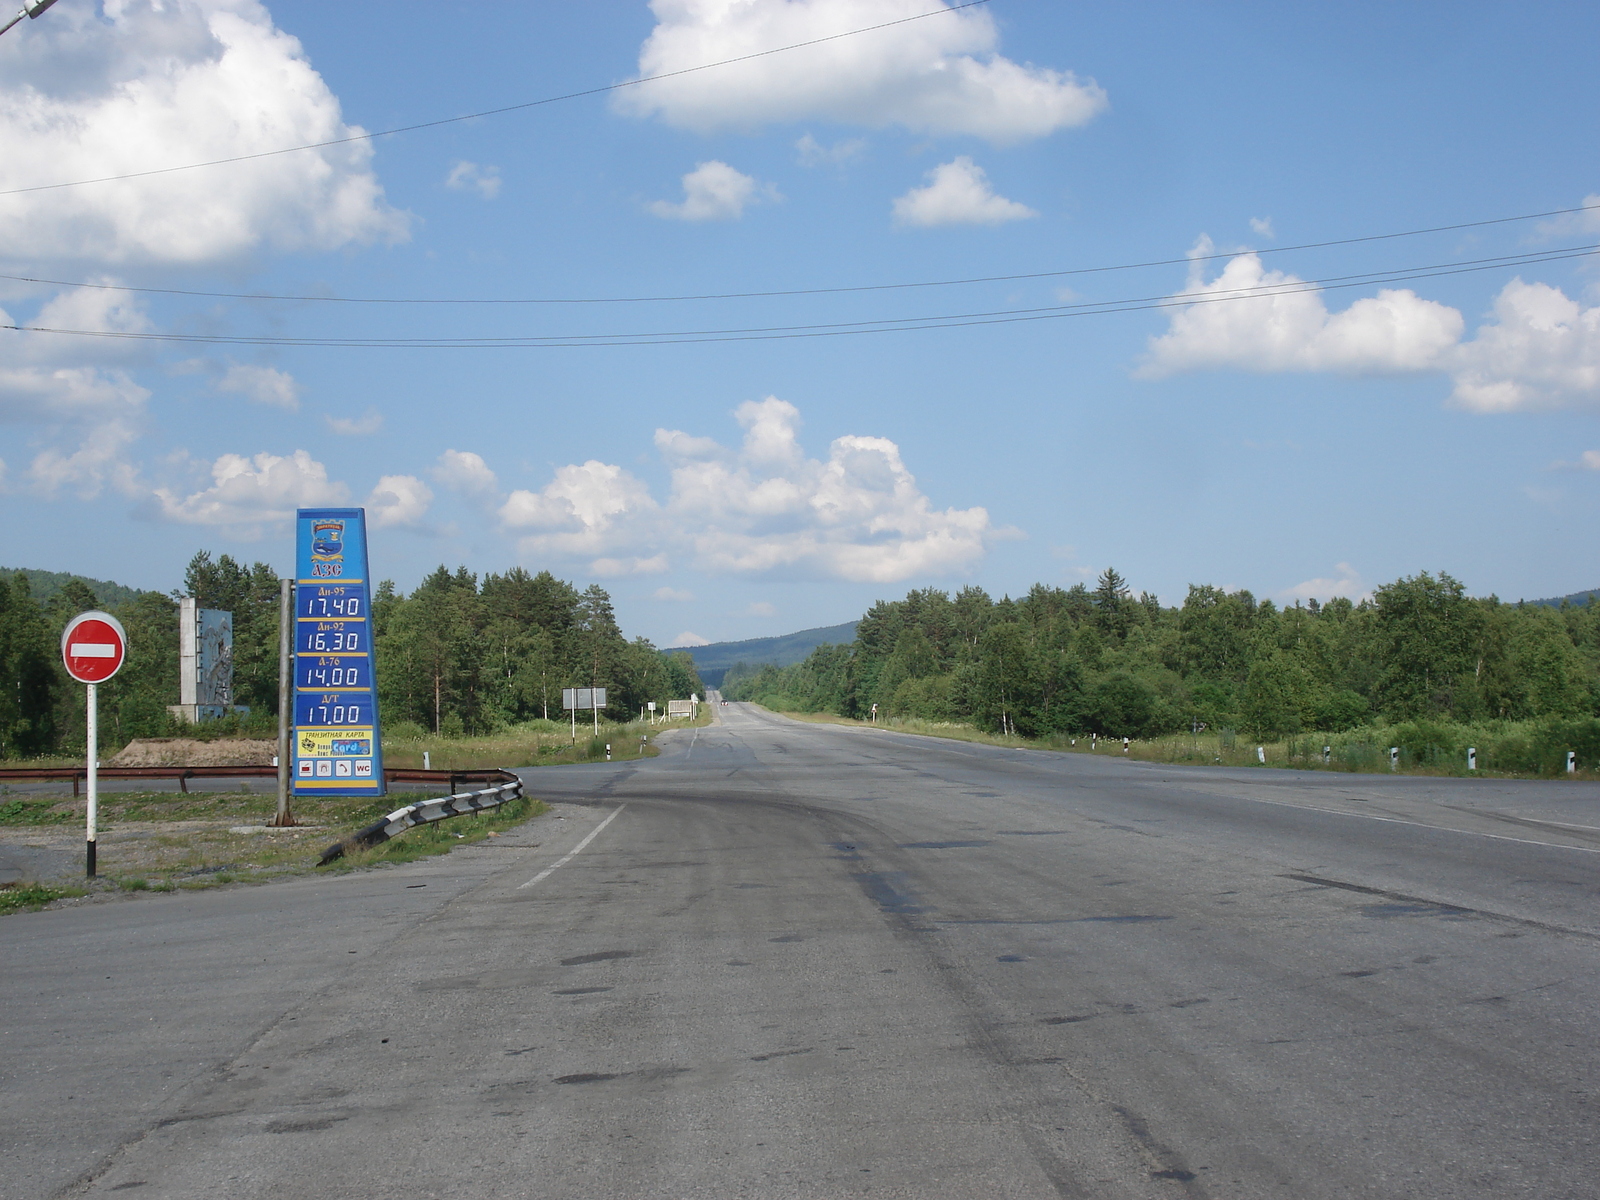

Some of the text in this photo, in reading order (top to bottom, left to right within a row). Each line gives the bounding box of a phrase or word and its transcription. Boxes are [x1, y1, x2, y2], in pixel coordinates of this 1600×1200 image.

[311, 563, 343, 577] АЗС
[318, 587, 345, 596] Ан-95
[309, 598, 359, 617] 17.40
[317, 622, 344, 631] Ан-92
[308, 633, 359, 652] 16.30
[318, 657, 340, 666] А-76
[307, 668, 358, 687] 14.00
[321, 695, 340, 703] Д/Т
[309, 706, 360, 725] 17.00
